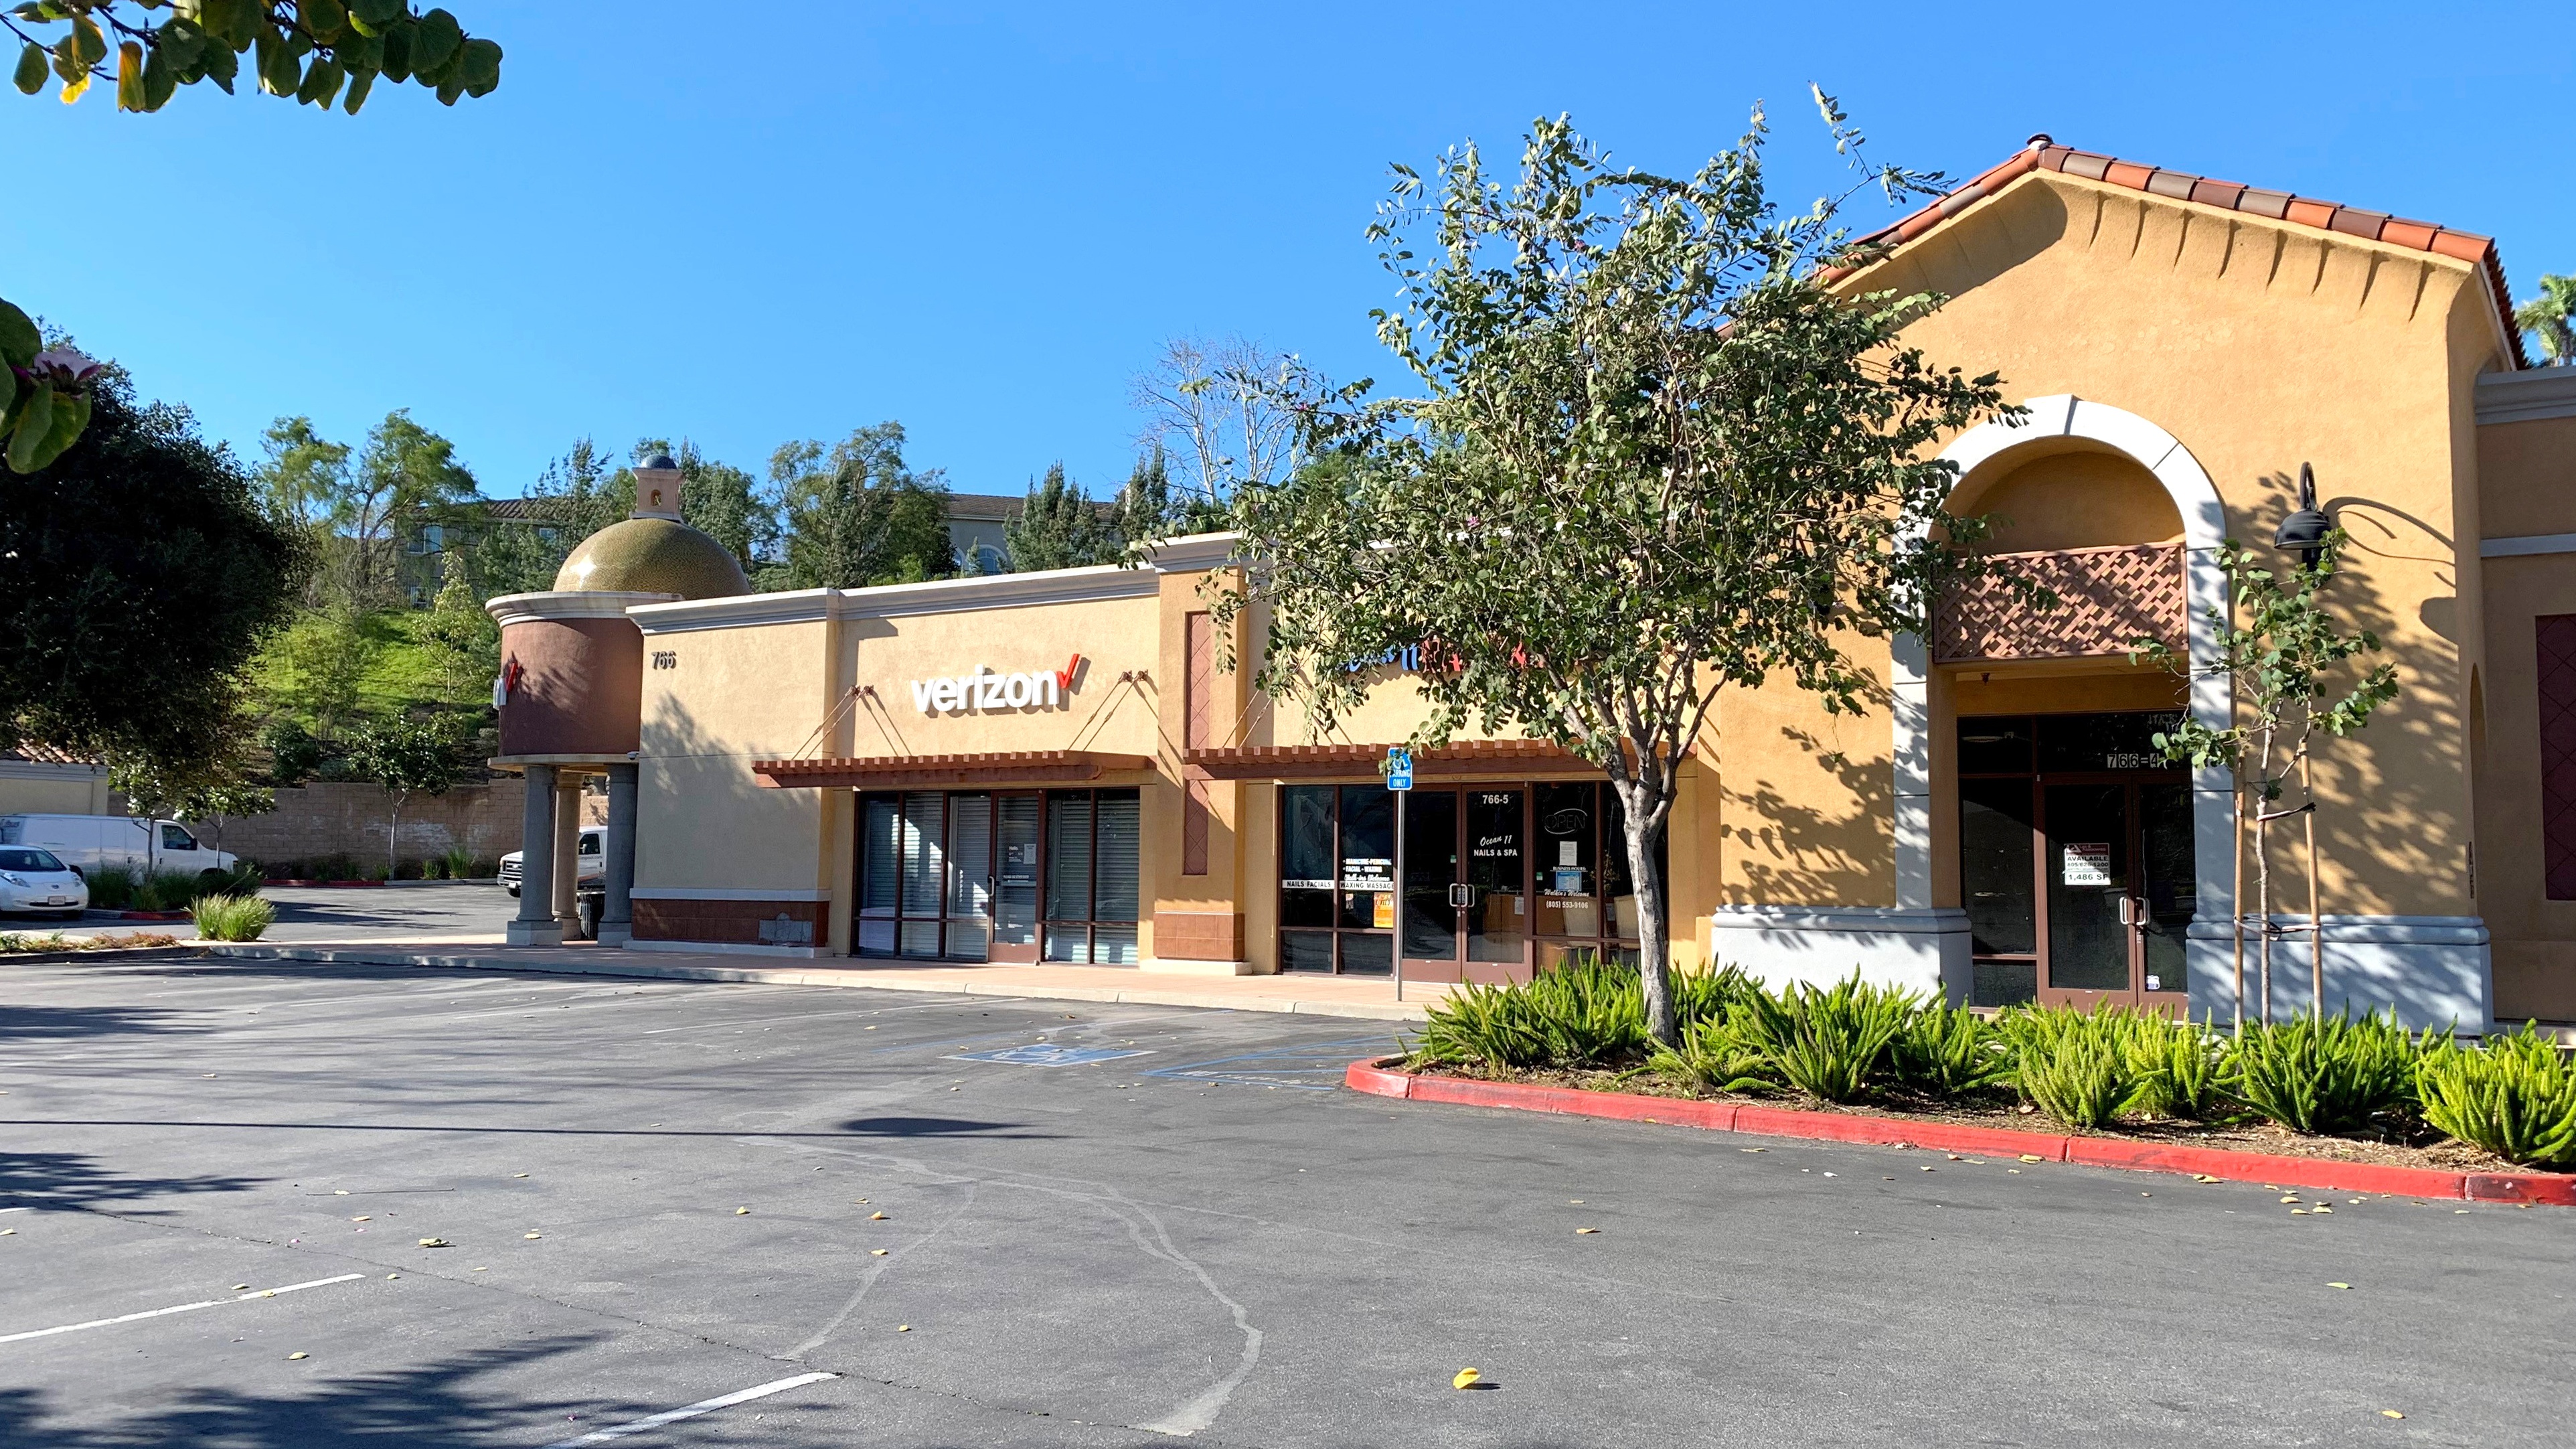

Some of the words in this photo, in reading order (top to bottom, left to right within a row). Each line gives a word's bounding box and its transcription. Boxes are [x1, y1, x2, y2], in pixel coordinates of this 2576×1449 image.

[651, 650, 675, 670] 766
[911, 664, 1060, 712] verizon
[1393, 779, 1406, 787] ONLY
[1482, 794, 1509, 804] 766-5
[1544, 814, 1585, 829] OPEN
[1480, 836, 1502, 846] Ocean
[1504, 834, 1512, 844] 11
[1546, 901, 1560, 909] (805)
